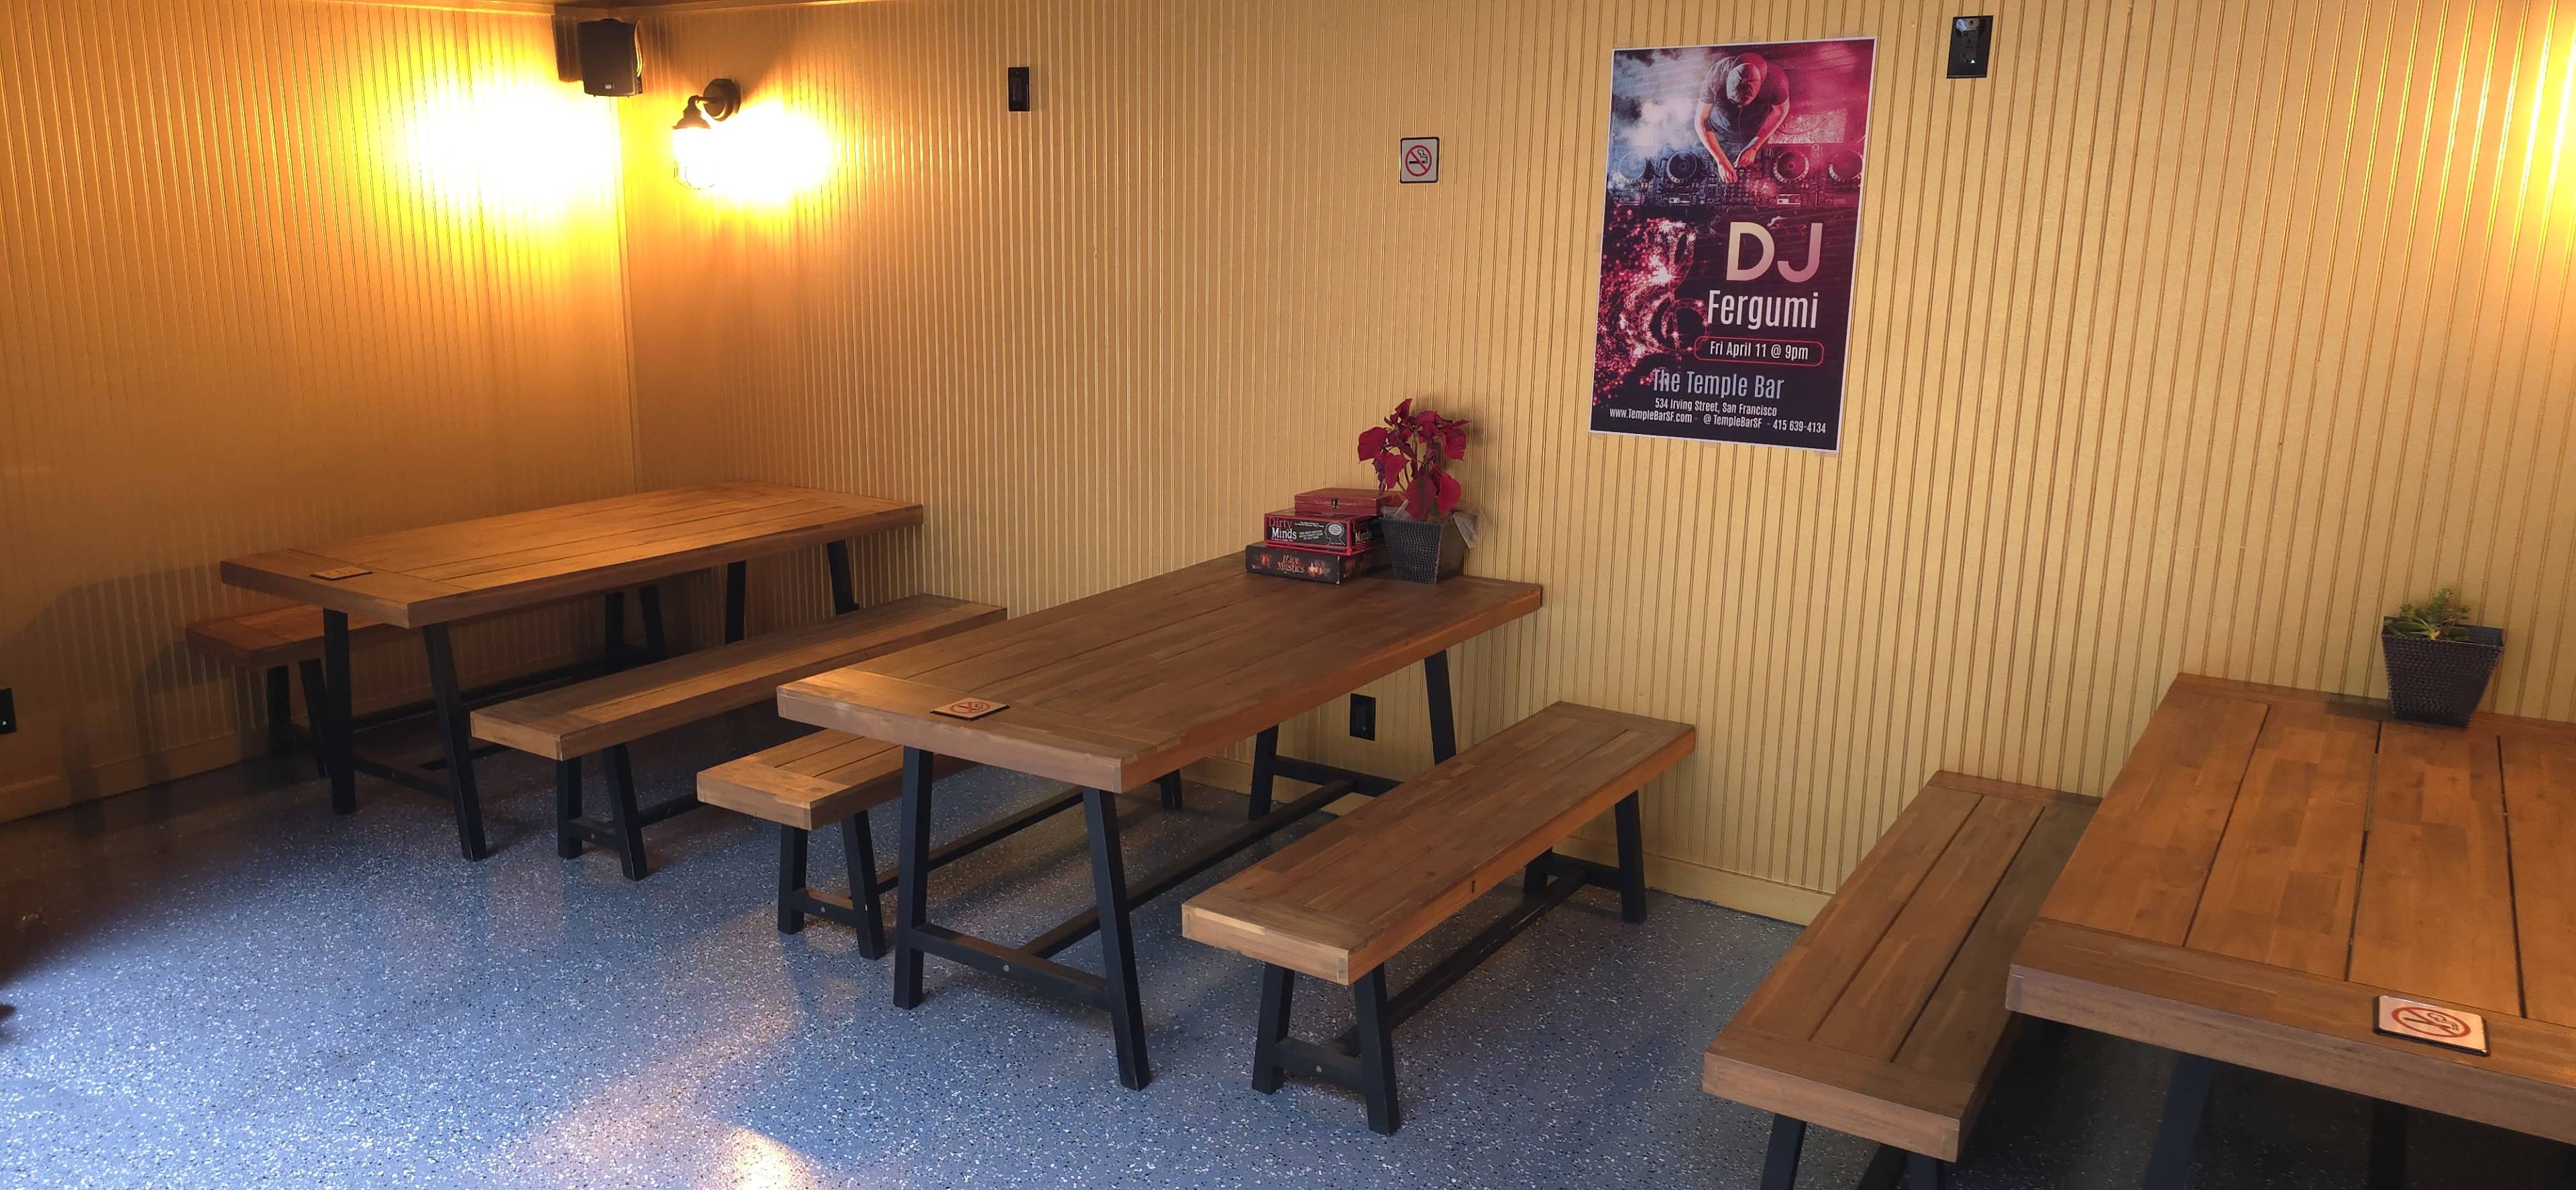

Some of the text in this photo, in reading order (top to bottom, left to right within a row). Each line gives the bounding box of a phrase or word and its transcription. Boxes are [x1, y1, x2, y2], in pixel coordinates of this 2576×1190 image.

[1726, 221, 1823, 283] DJ
[1707, 290, 1819, 329] Fergumi
[1710, 341, 1809, 360] Fri April 11 @ 9pm
[1652, 369, 1784, 399] The Temple Bar
[1655, 398, 1777, 417] 534 Irving Street, San Francisco
[1610, 409, 1693, 423] www.TempleBarSF.com
[1713, 415, 1762, 429] TempleBarSF
[1773, 419, 1787, 431] 415
[1789, 421, 1826, 433] 639-4134
[1269, 517, 1293, 529] Dirty
[1272, 527, 1297, 539] Minds
